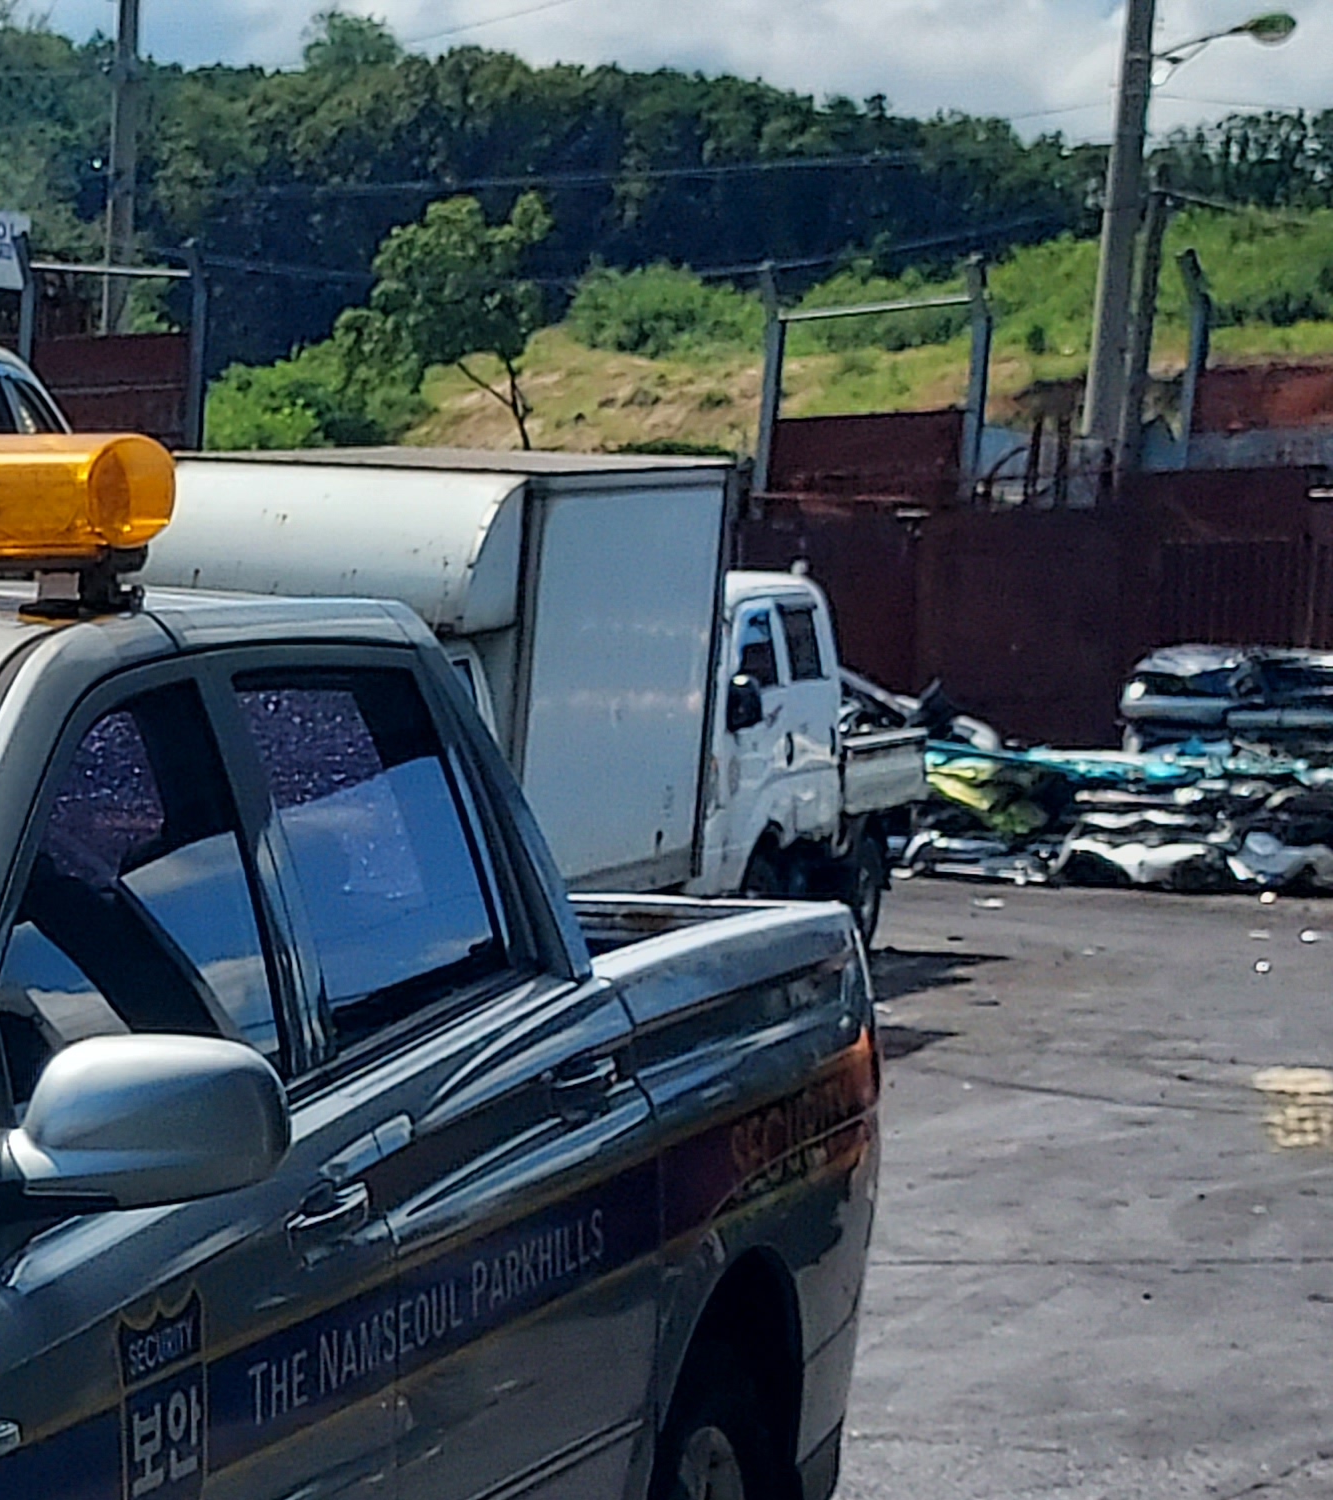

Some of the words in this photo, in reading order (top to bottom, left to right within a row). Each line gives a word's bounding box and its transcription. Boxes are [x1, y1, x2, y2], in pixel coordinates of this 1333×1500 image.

[129, 1317, 195, 1377] SECURITY
[247, 1350, 309, 1426] THE
[318, 1278, 464, 1394] NAMSEOUL
[470, 1208, 605, 1319] PARKHILLS
[132, 1384, 202, 1499] 보안
